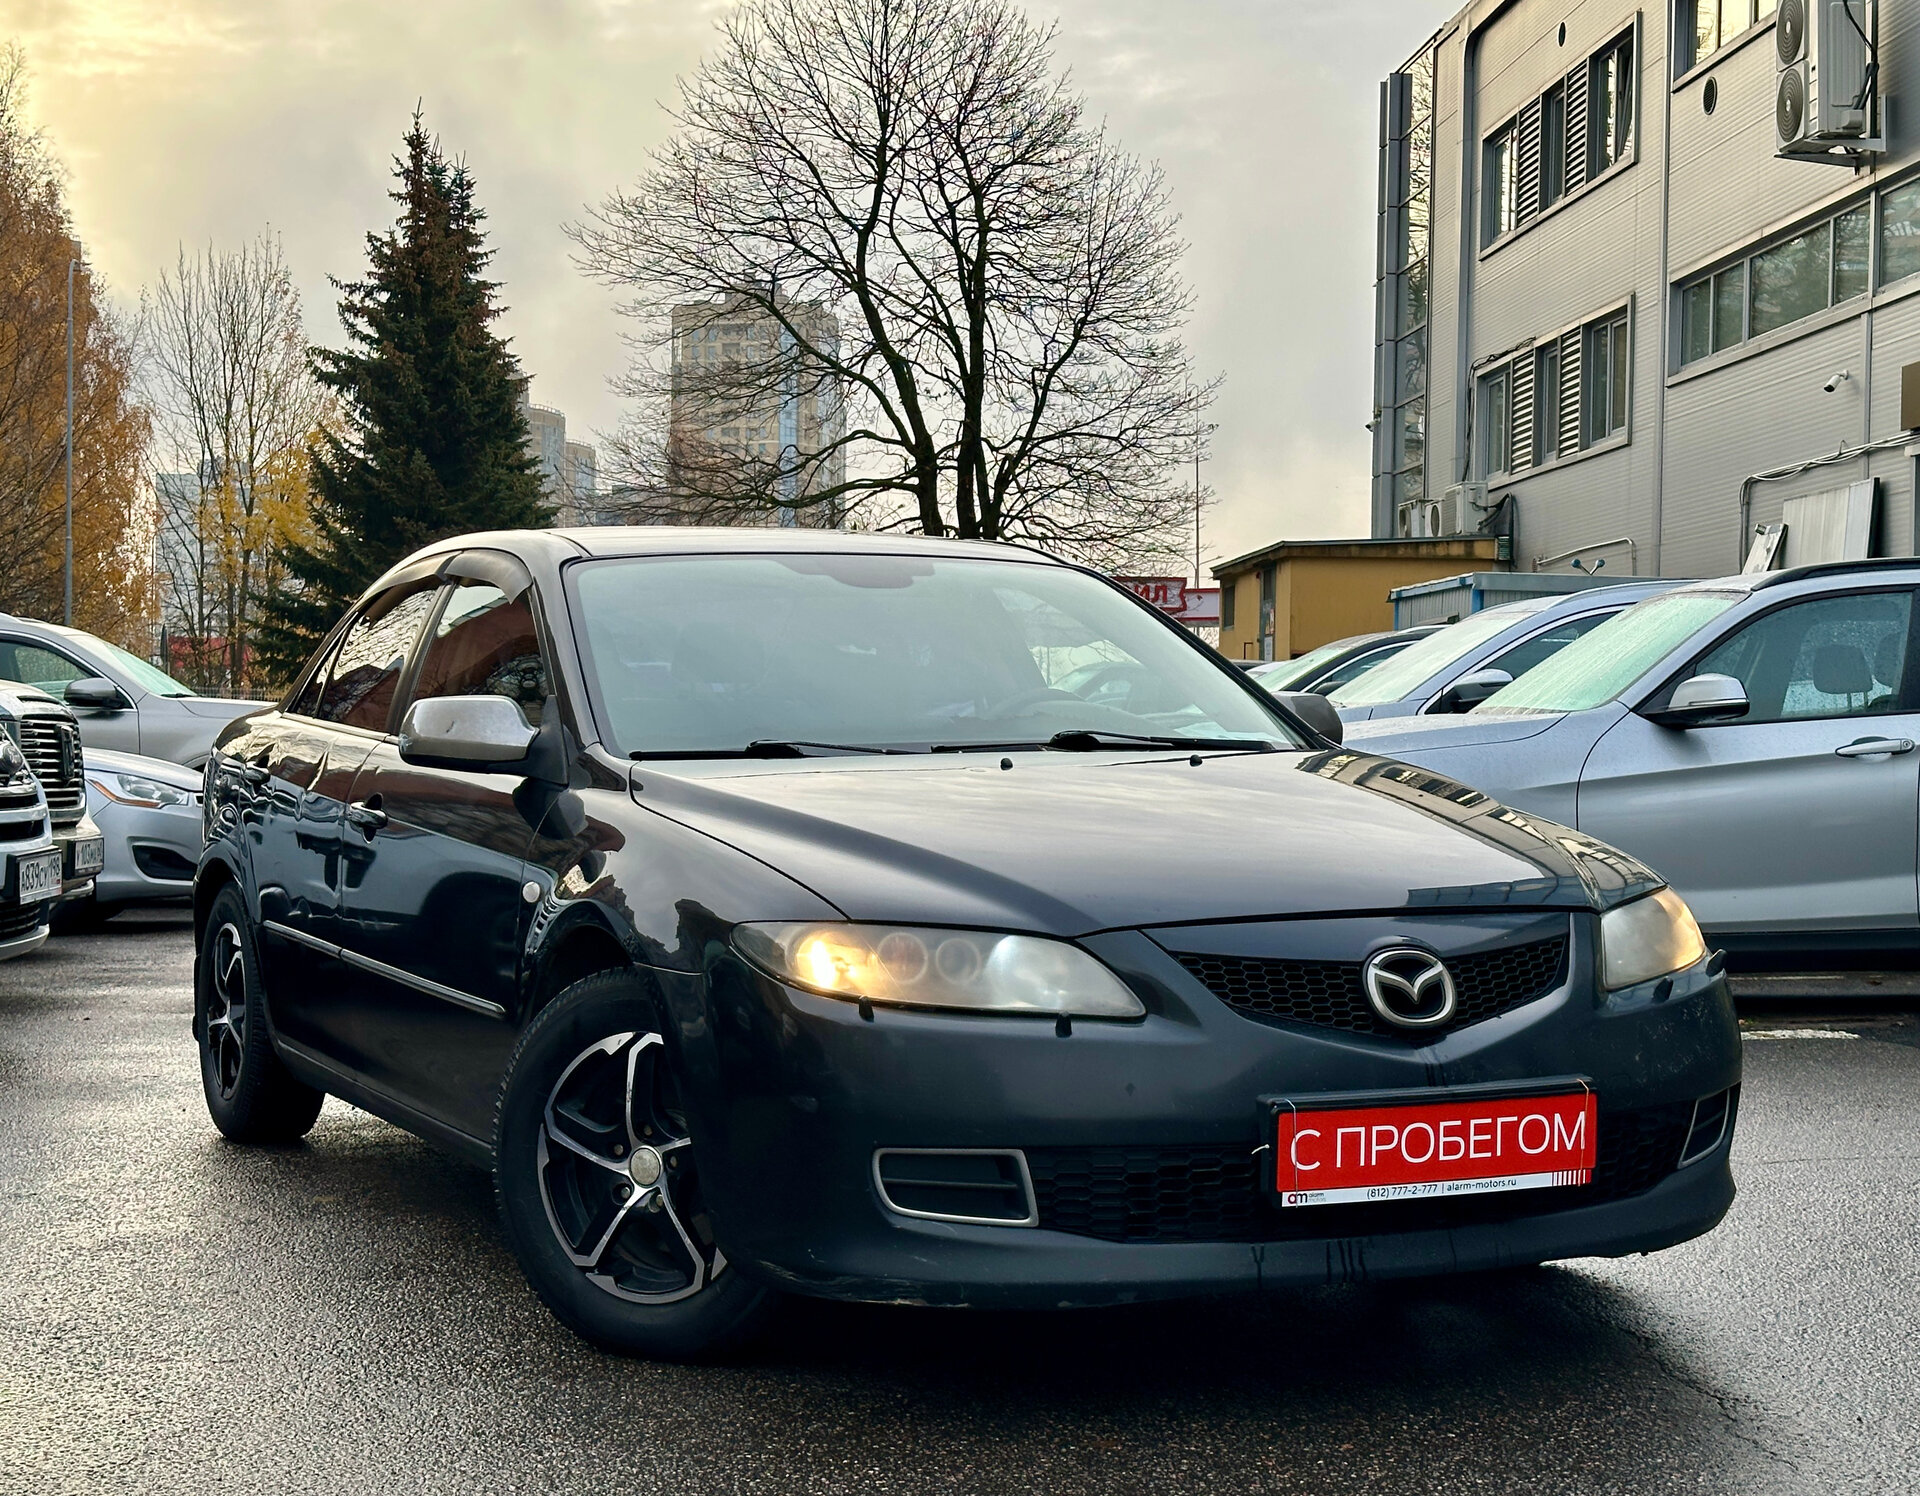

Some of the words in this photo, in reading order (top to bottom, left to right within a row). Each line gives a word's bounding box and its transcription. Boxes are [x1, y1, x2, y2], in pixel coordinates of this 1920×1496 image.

[1290, 1129, 1321, 1171] С
[1336, 1111, 1587, 1168] ПРОБЕГОМ
[1367, 1187, 1389, 1199] (812)
[1392, 1184, 1437, 1196] 777-2-777
[1447, 1178, 1516, 1192] alarm-motors.ru
